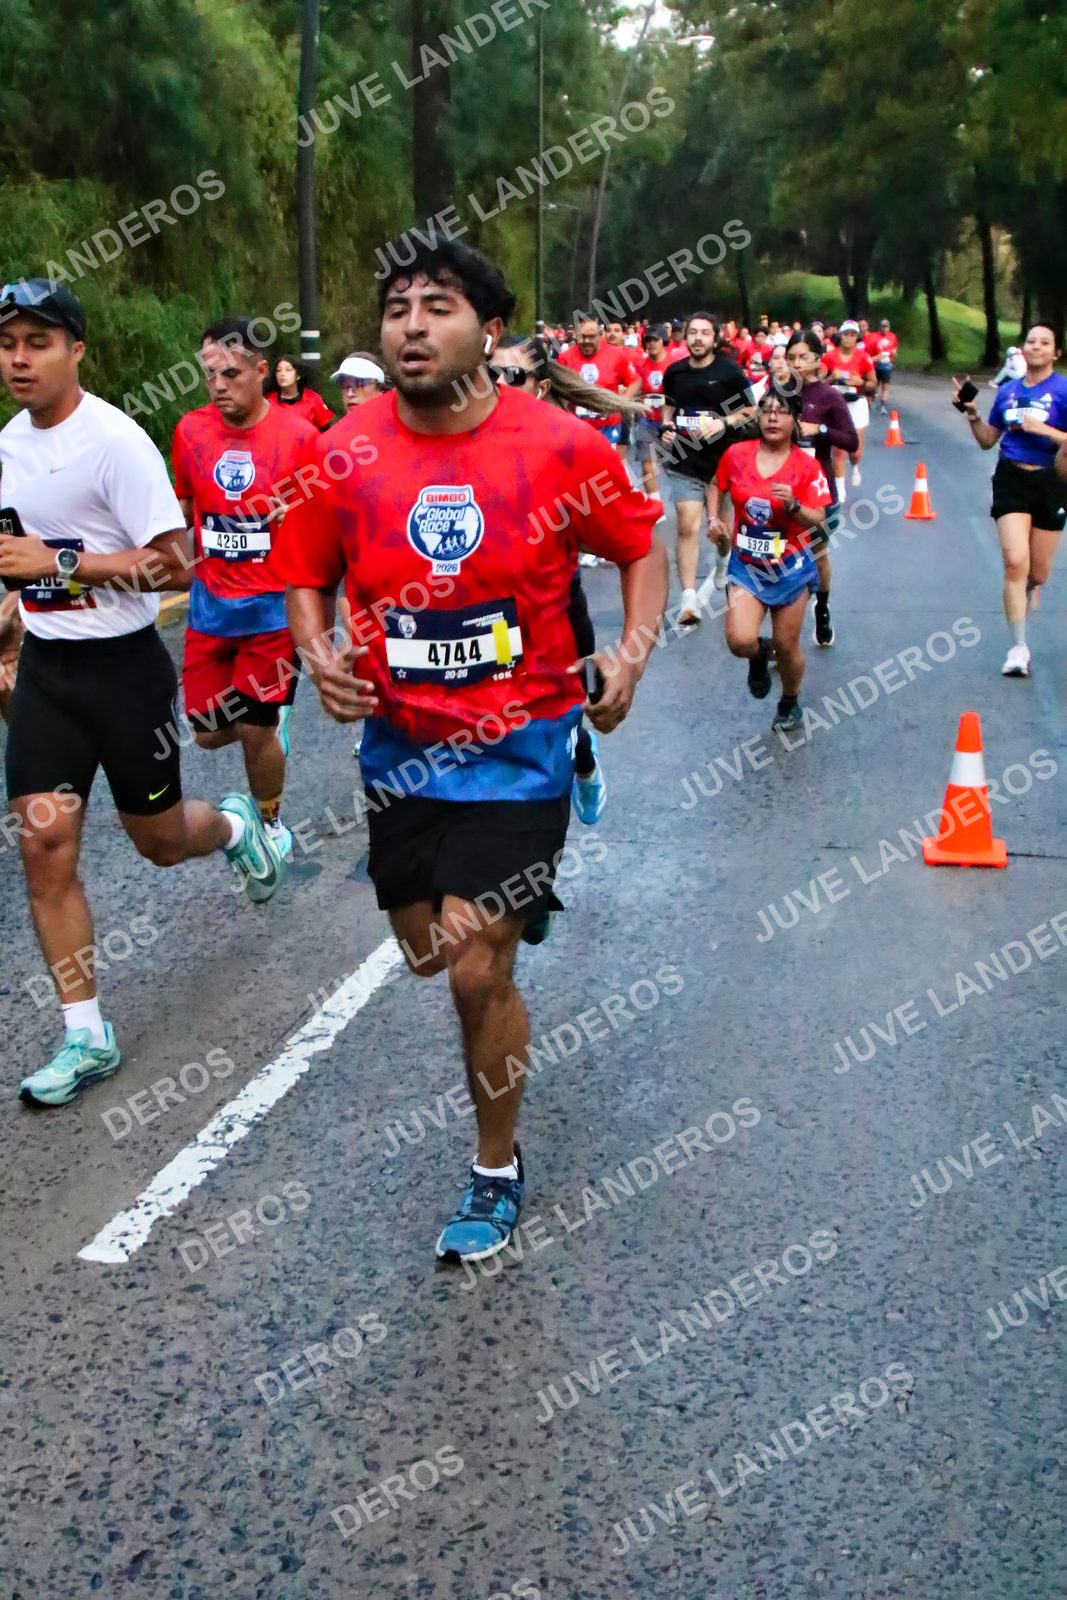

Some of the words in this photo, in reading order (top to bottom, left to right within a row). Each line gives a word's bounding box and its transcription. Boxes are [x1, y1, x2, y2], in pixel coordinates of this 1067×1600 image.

[426, 494, 466, 502] BIMBO
[427, 507, 466, 521] Global
[419, 520, 450, 532] Race
[217, 533, 248, 549] 4250
[747, 538, 770, 552] 5328
[436, 563, 458, 573] 2026
[428, 639, 482, 666] 4744
